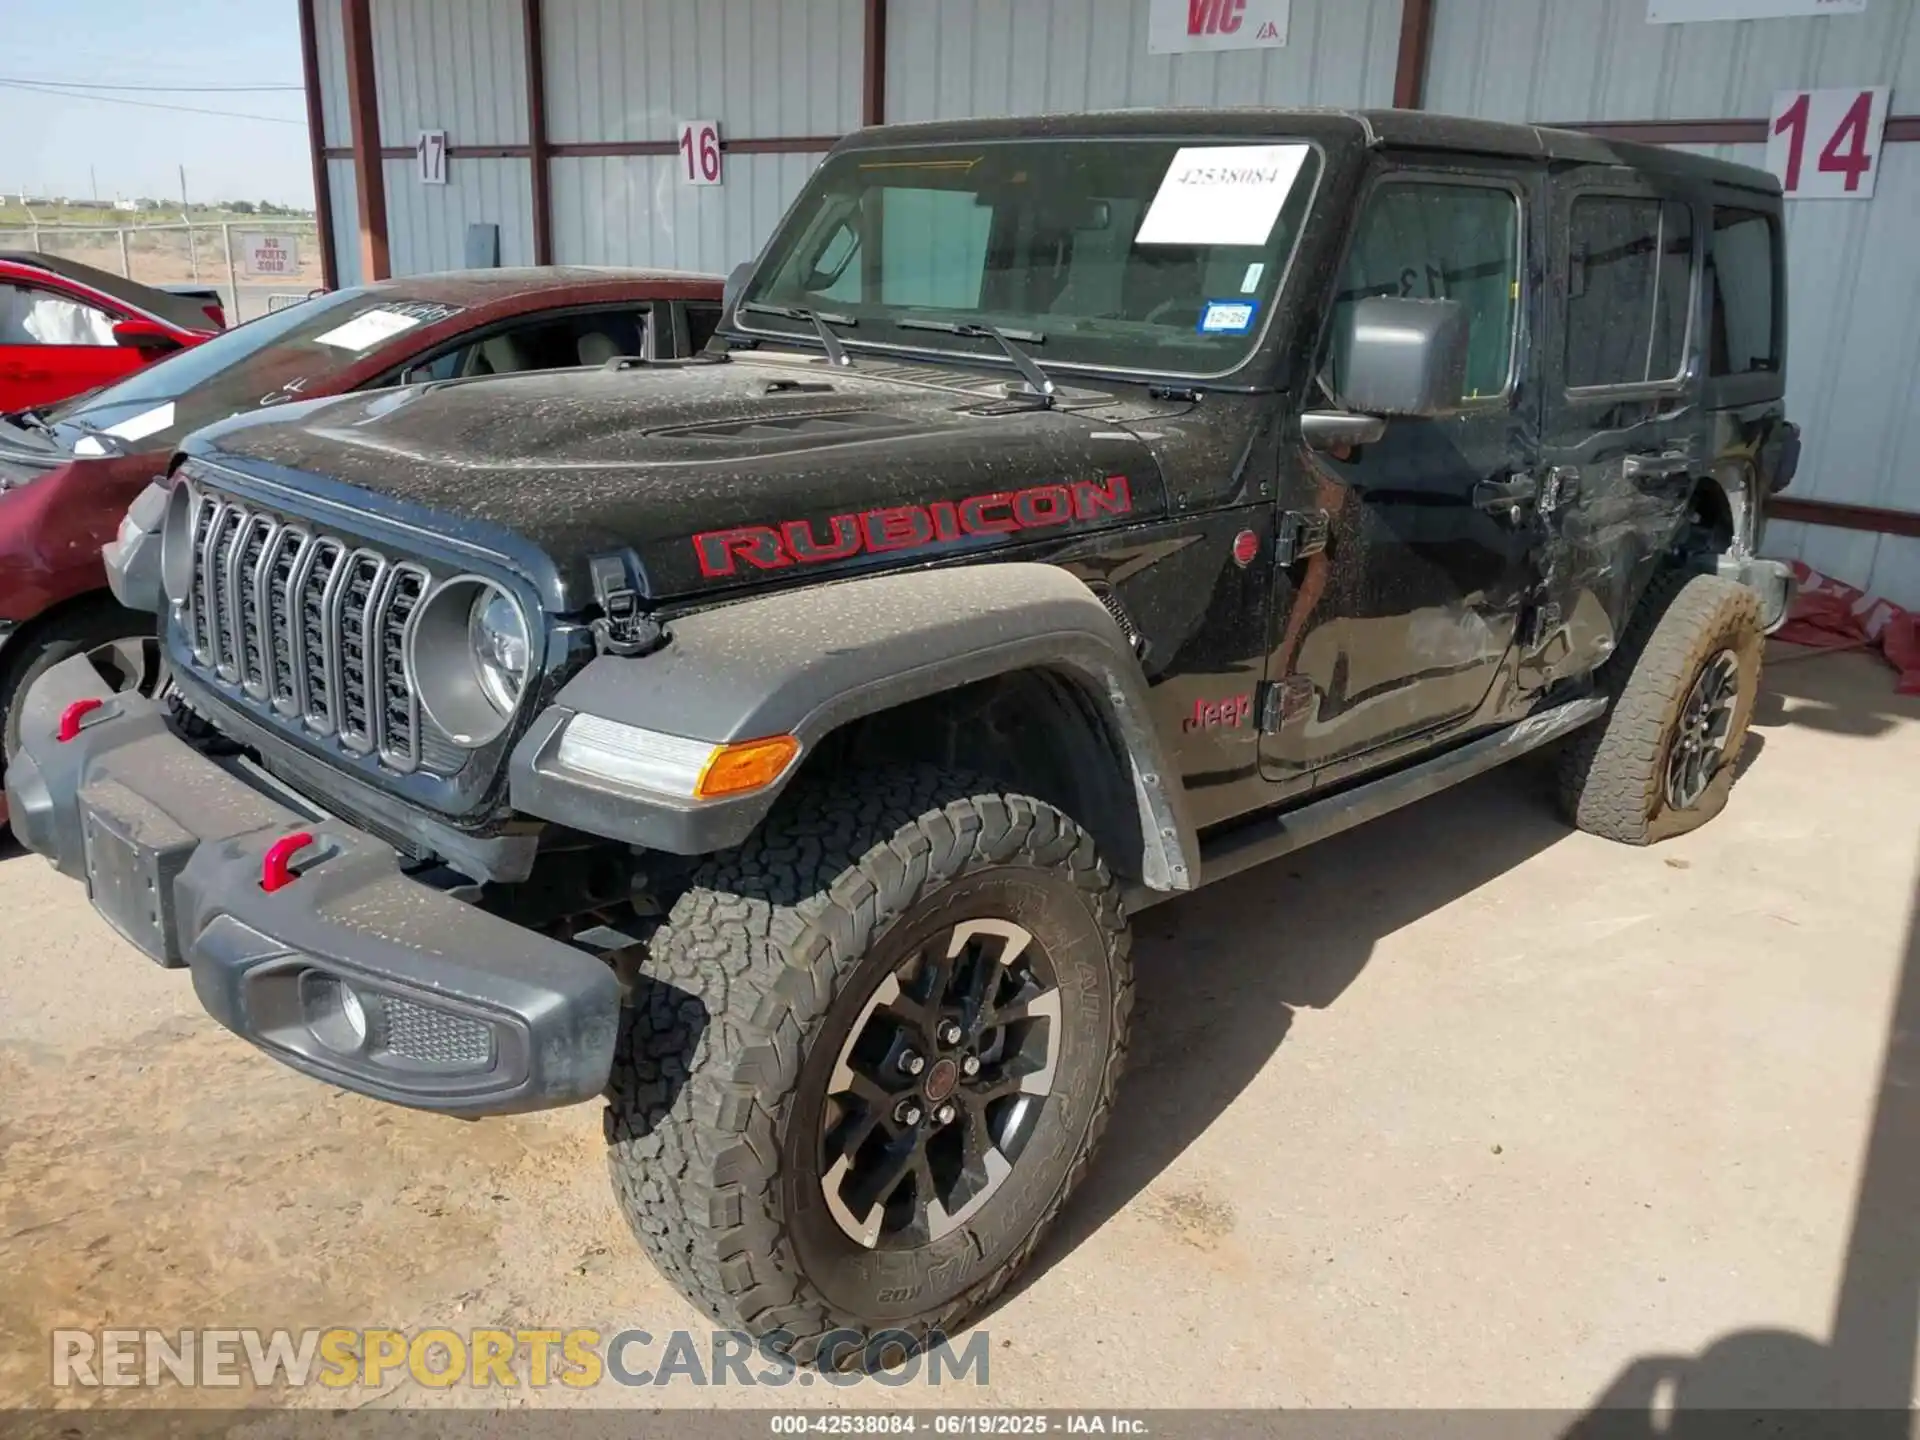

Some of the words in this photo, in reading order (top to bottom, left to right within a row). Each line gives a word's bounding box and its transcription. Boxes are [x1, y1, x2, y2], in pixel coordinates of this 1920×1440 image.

[417, 134, 443, 179] 17
[681, 127, 719, 181] 16
[1775, 91, 1873, 191] 14
[1178, 168, 1278, 185] 42538084
[692, 476, 1132, 578] RUBICON
[1183, 693, 1250, 734] Jeep
